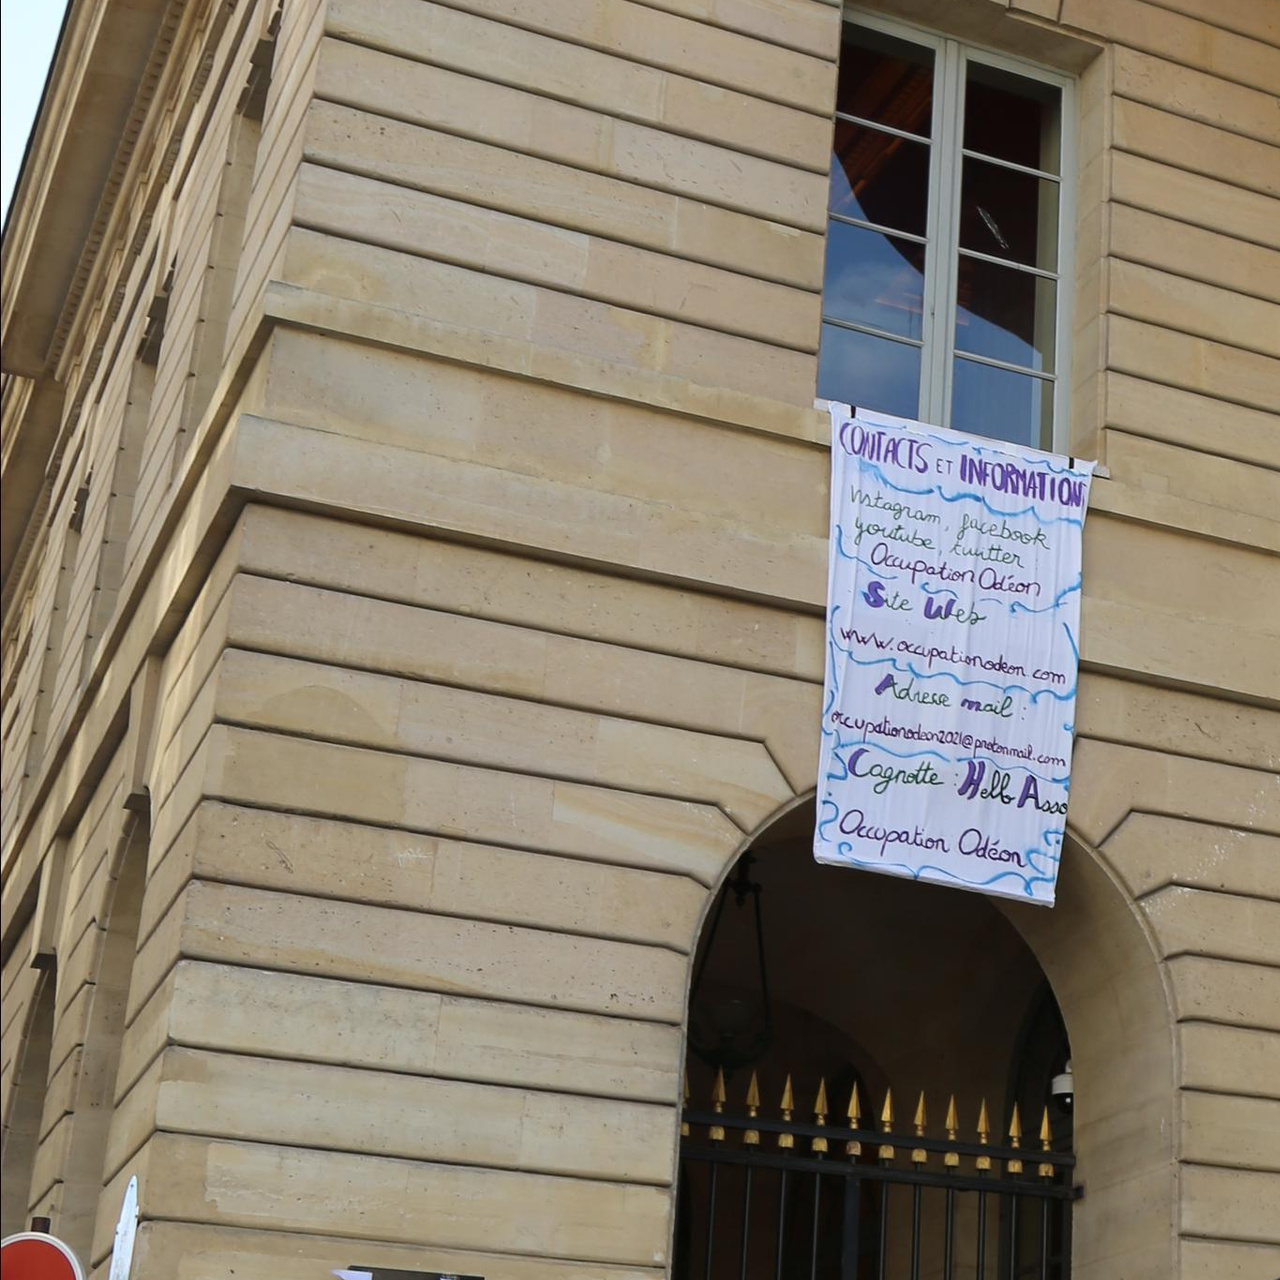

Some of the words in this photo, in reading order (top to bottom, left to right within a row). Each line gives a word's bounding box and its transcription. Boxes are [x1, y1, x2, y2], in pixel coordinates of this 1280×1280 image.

[839, 422, 933, 474] CONTACTS
[936, 458, 953, 475] ET
[959, 514, 1050, 550] facebook
[870, 542, 975, 584] Occupation
[978, 567, 1042, 597] Odéon
[950, 542, 1024, 569] twitter
[863, 580, 913, 611] Site
[923, 597, 987, 625] Web
[960, 695, 1014, 718] mail
[848, 748, 944, 794] Cagnotte
[839, 809, 949, 857] Occupation
[958, 828, 1027, 868] Odéon
